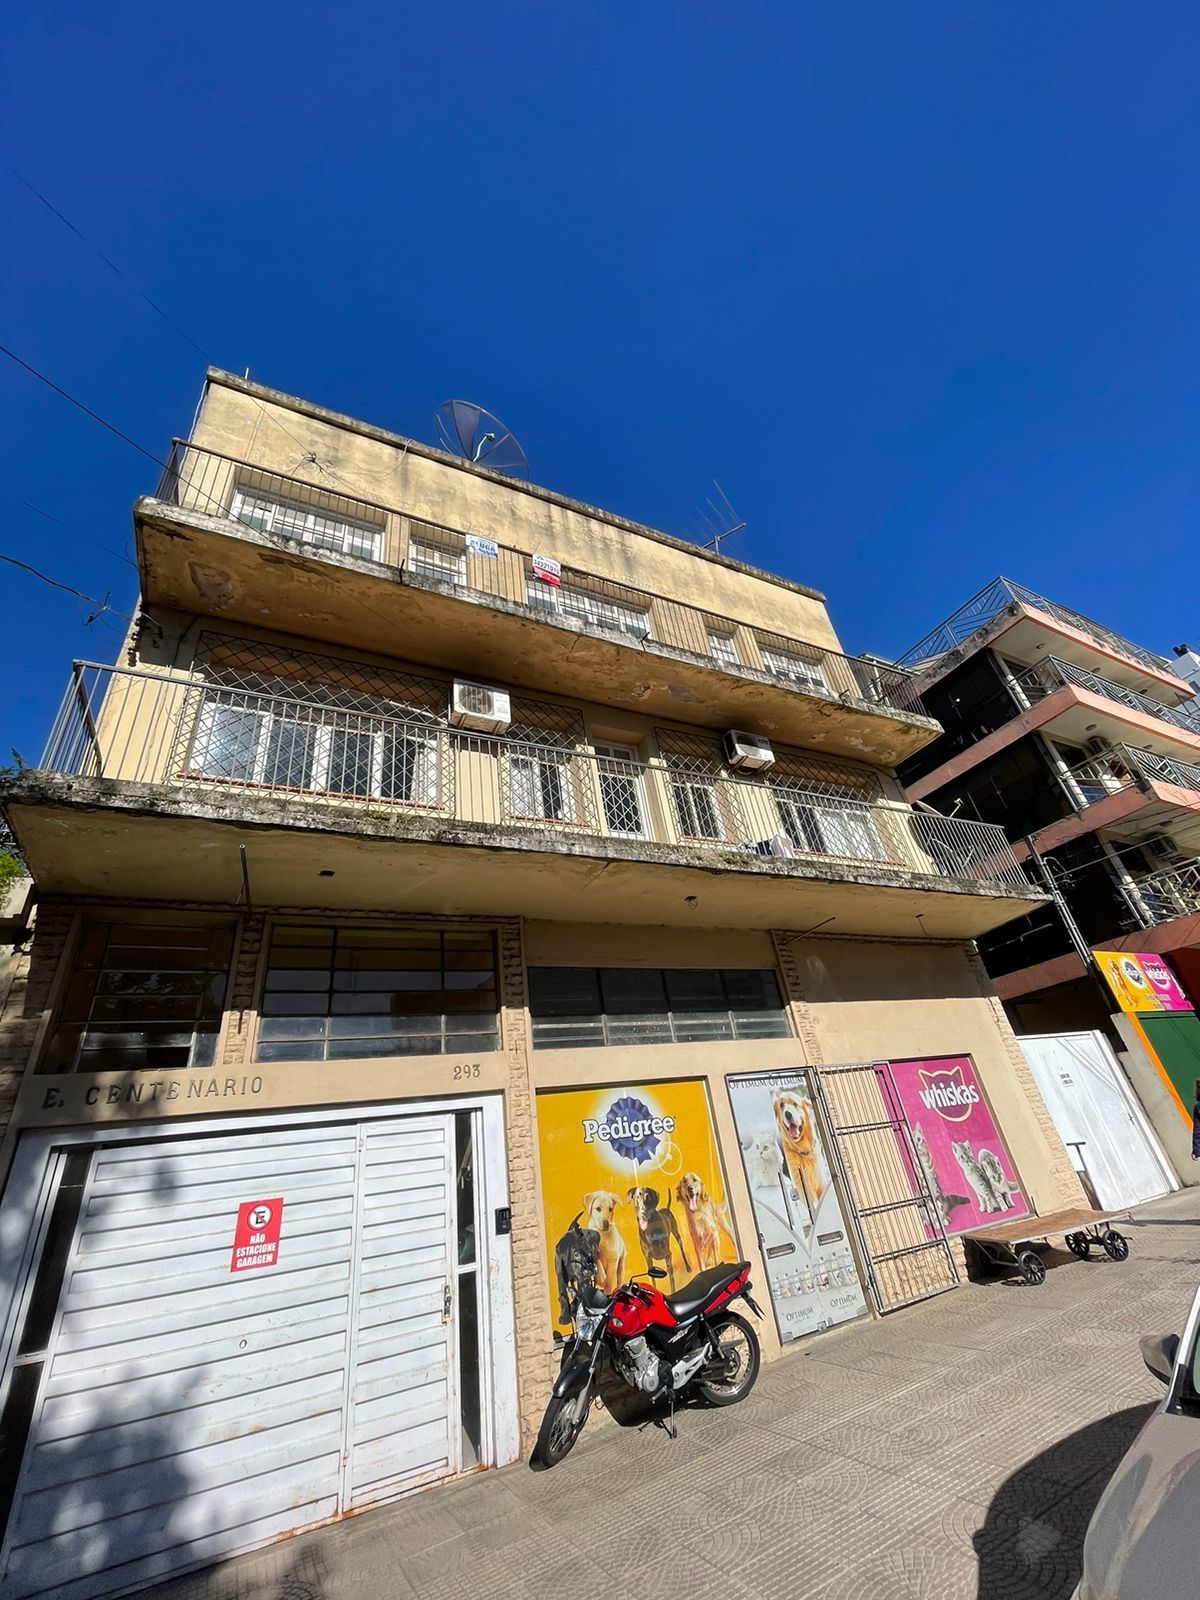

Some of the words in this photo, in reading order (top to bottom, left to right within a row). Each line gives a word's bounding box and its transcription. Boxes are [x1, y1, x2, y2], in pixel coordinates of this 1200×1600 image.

[453, 1064, 481, 1081] 293
[42, 1087, 65, 1109] E.
[85, 1076, 263, 1106] CENTENARIO
[582, 1116, 675, 1144] Pedigree
[249, 1233, 267, 1245] NÃO
[236, 1242, 277, 1258] ESTACIONE
[236, 1253, 273, 1269] GARAGEM
